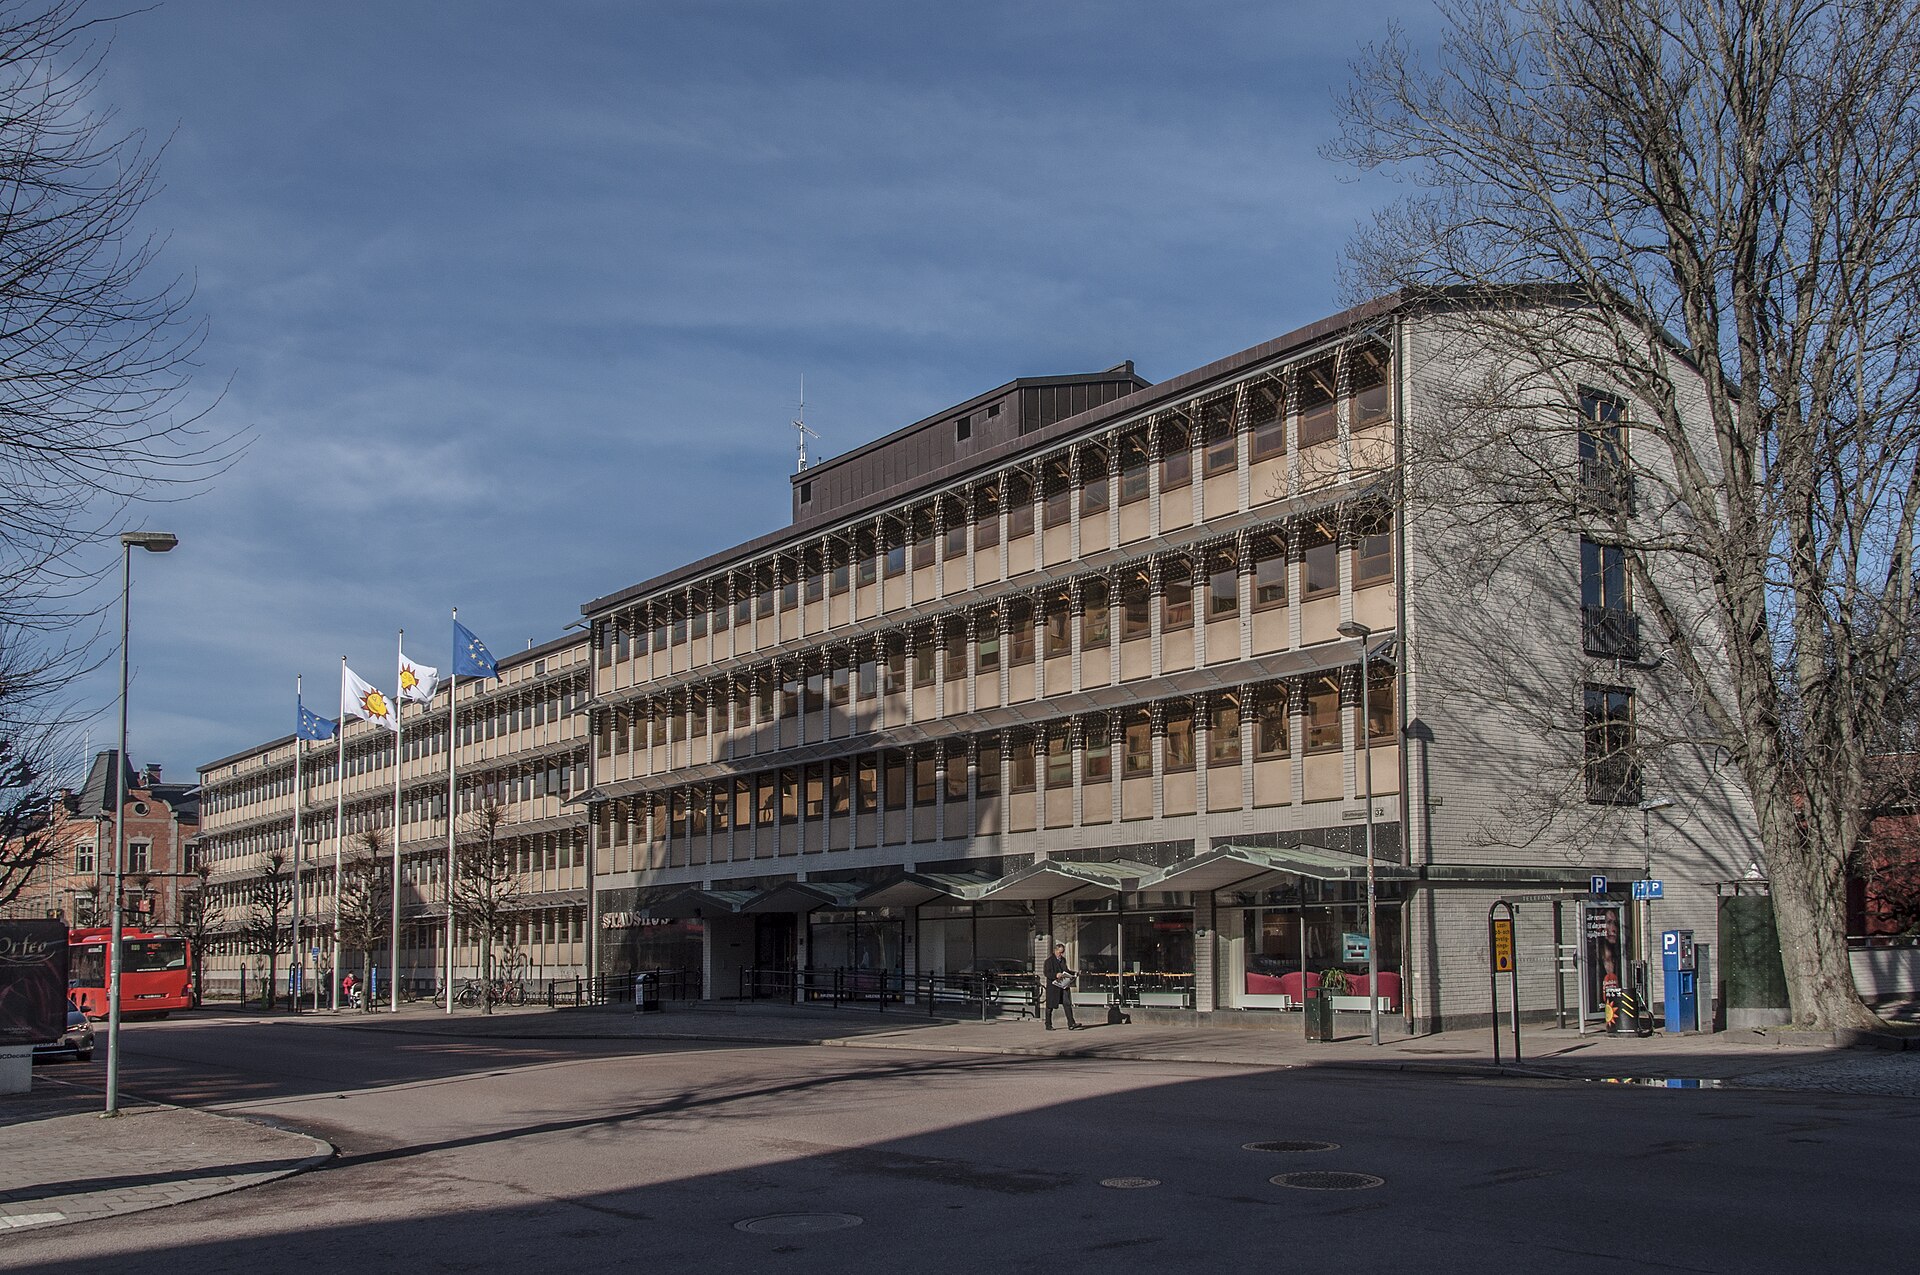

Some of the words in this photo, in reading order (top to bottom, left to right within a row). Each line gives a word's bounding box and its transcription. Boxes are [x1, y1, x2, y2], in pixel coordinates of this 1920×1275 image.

[1595, 878, 1603, 893] P
[1637, 883, 1645, 893] P
[1652, 882, 1659, 892] P
[0, 933, 48, 956] Orfeo
[1664, 933, 1676, 950] P
